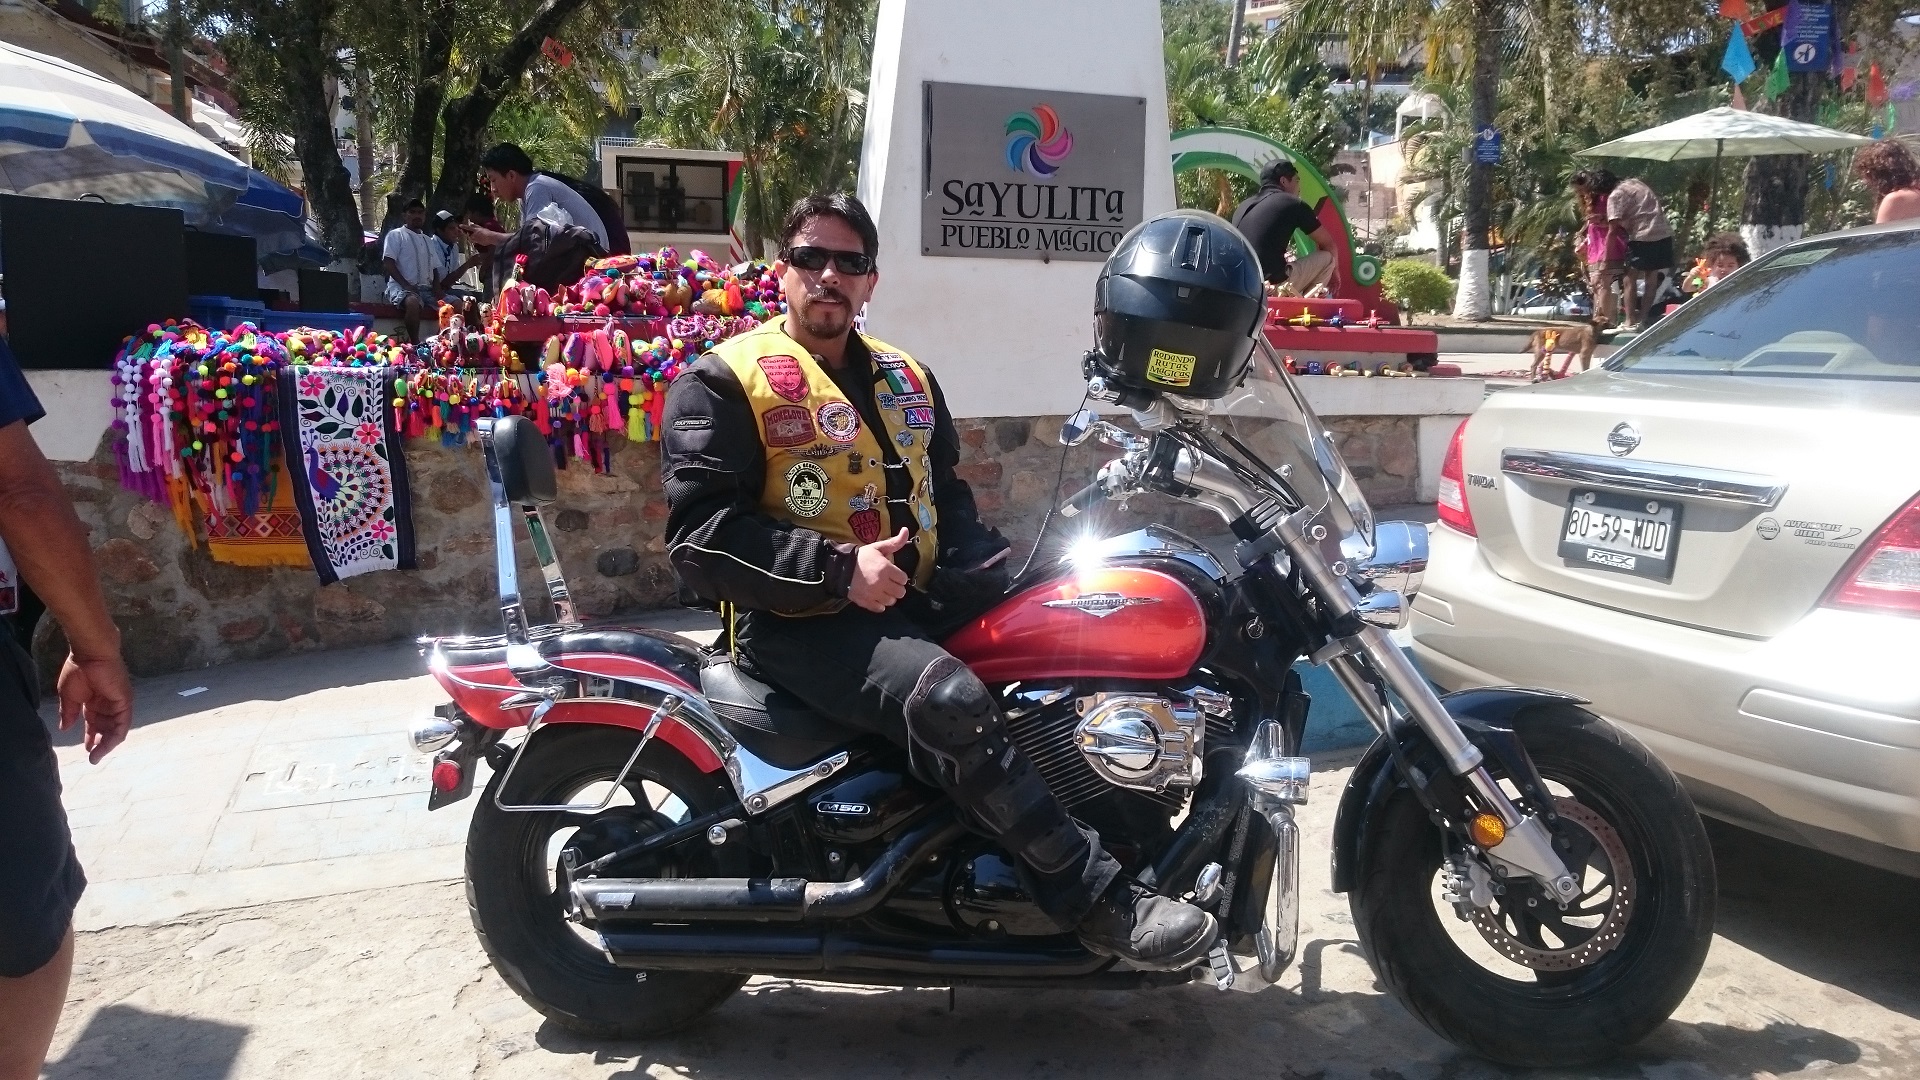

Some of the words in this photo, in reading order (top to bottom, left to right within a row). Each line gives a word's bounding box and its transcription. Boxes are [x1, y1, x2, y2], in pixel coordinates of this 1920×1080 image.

[1568, 509, 1667, 551] 80-59-MDD
[1784, 519, 1842, 533] AUTOMOTRIZ
[1794, 529, 1825, 540] SIERRA
[822, 803, 865, 812] M50
